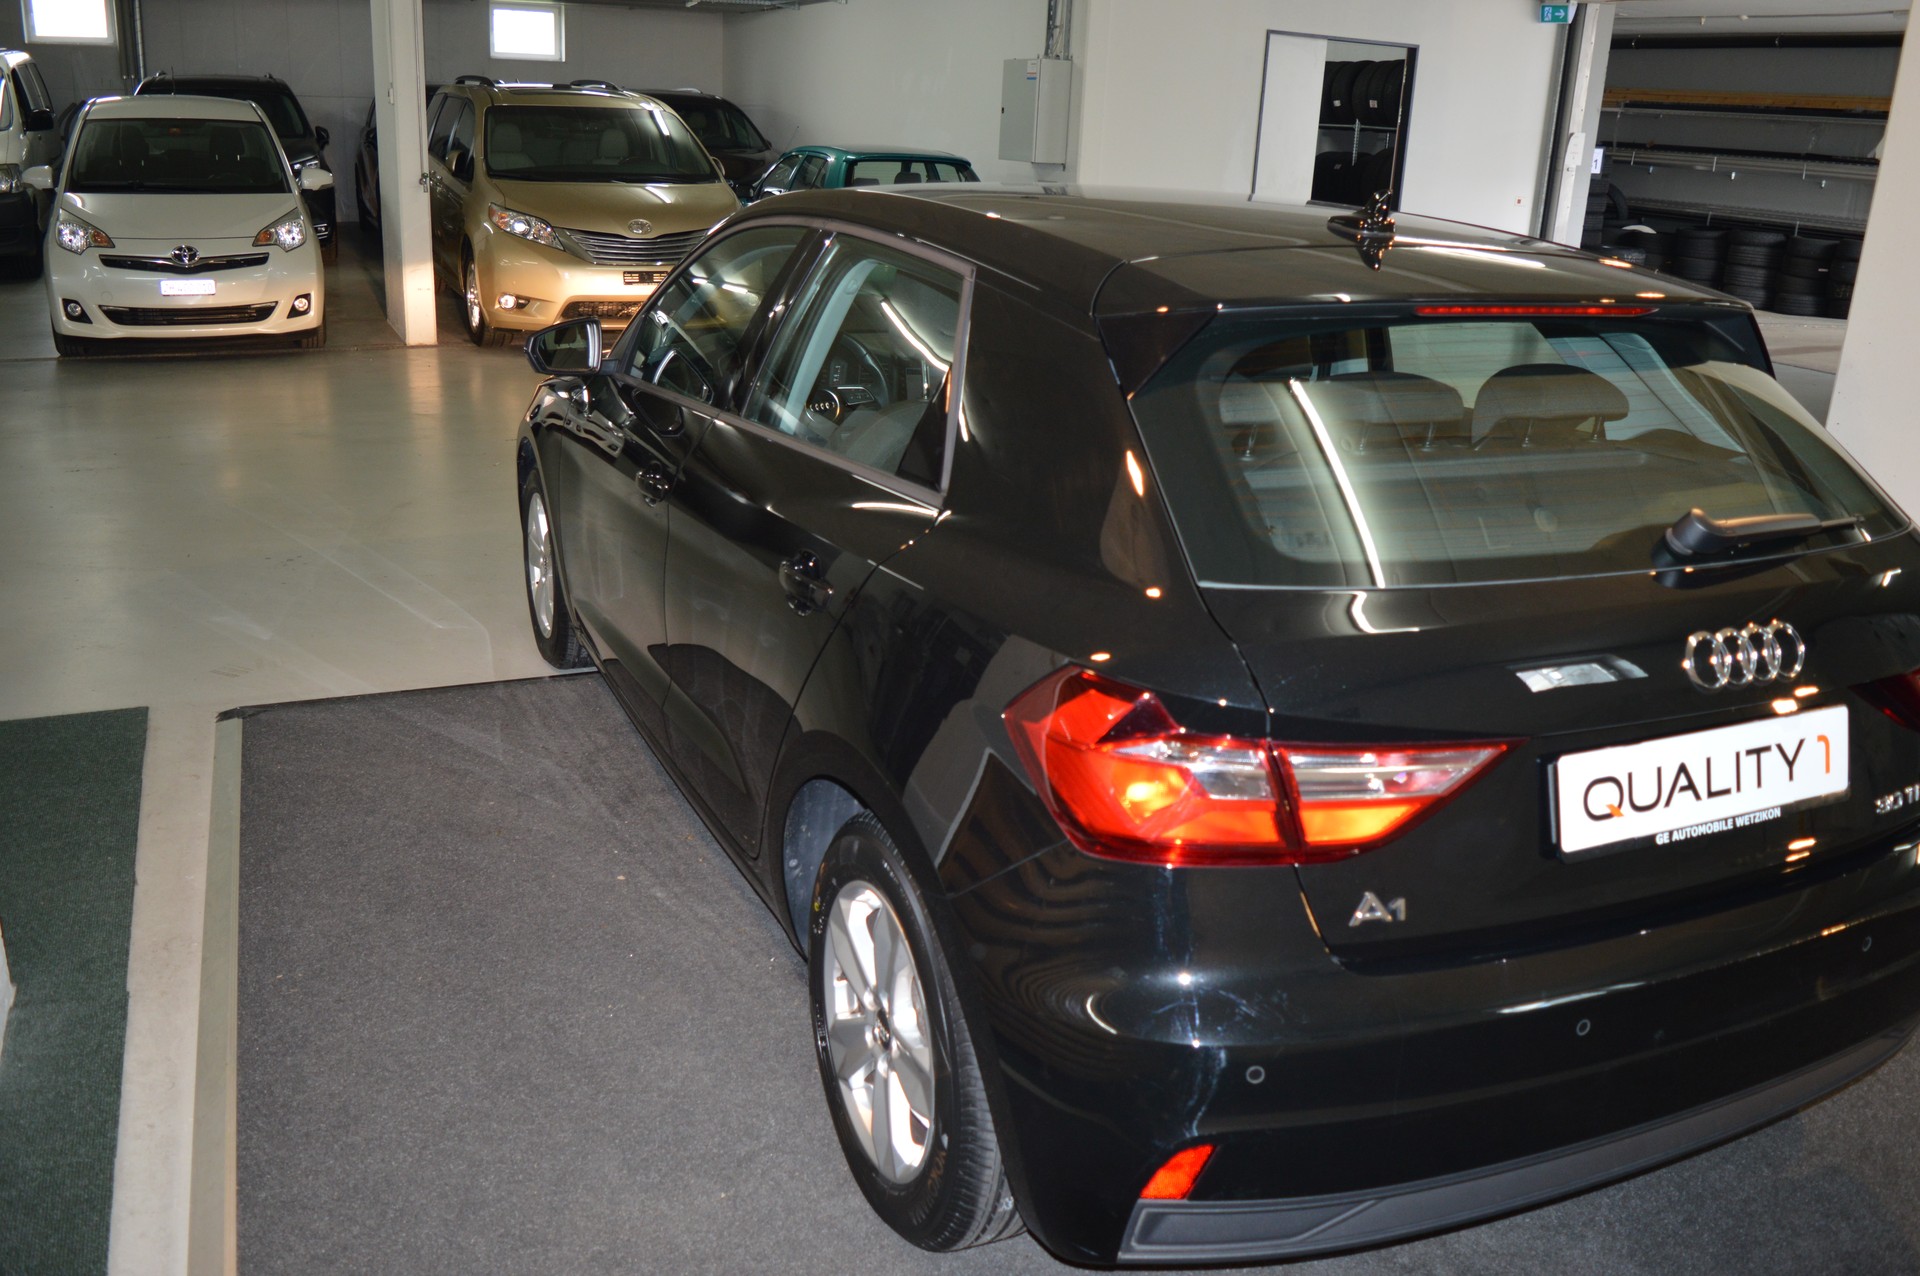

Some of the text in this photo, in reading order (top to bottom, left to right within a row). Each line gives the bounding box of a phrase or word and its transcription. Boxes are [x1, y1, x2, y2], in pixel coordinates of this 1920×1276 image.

[1583, 735, 1831, 822] QUALITY 1
[1655, 806, 1782, 846] GE AUTOMOBILE WETZIKON
[1347, 890, 1406, 928] A1
